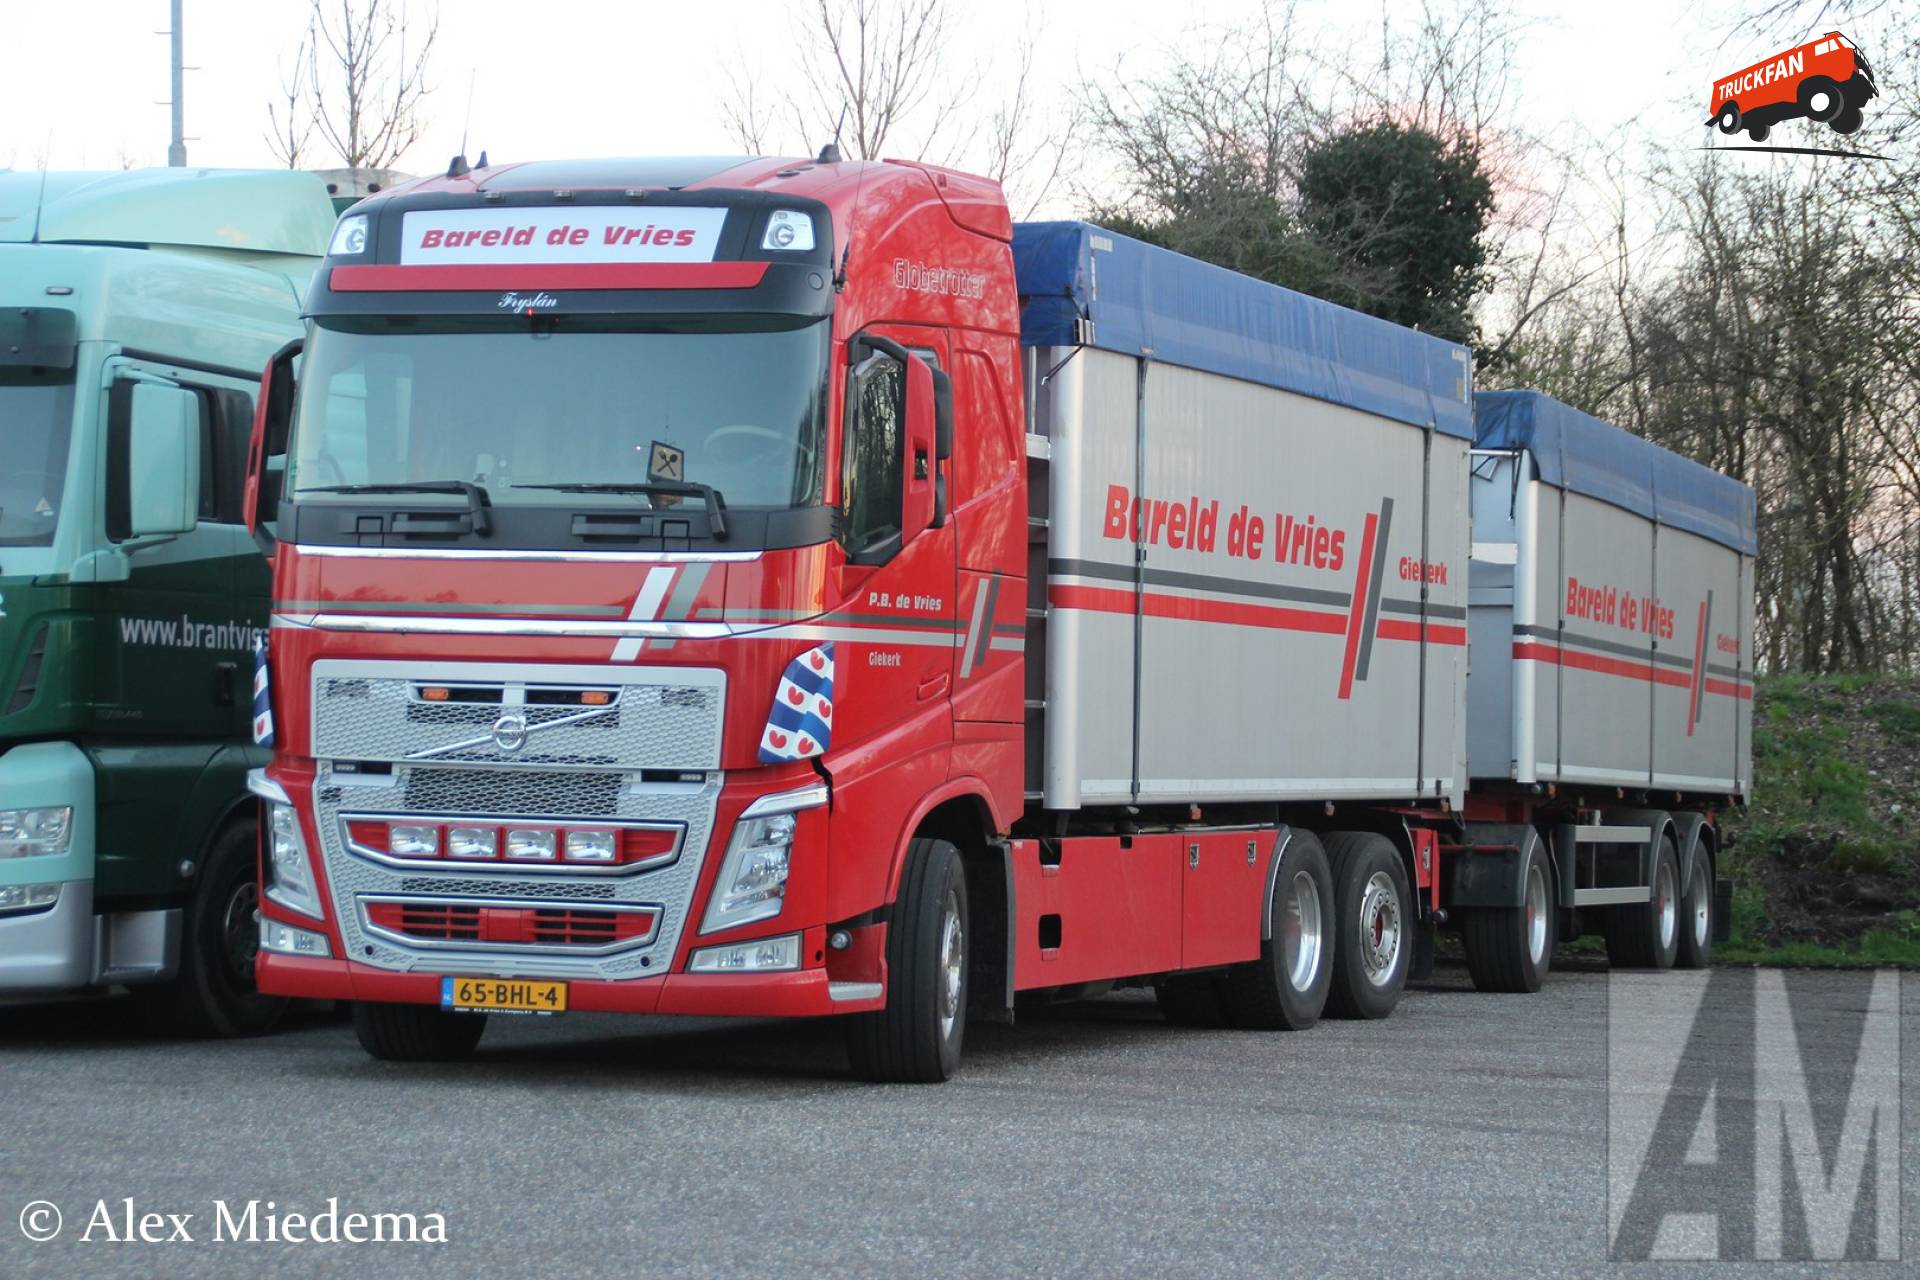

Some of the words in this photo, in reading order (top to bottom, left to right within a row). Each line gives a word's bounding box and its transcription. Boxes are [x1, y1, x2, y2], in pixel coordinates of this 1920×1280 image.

[420, 226, 537, 249] Bareld
[546, 225, 590, 246] de
[603, 224, 696, 247] Vries
[1103, 483, 1219, 553] Bareld
[1227, 505, 1265, 561] de
[1275, 513, 1345, 572] Vries
[869, 592, 892, 608] P.B.
[896, 594, 911, 609] de
[914, 595, 942, 611] Vries
[1566, 576, 1617, 625] Bareld
[1619, 591, 1637, 632] de
[868, 651, 901, 667] Giekerk
[460, 982, 558, 1007] 65-BHL-4
